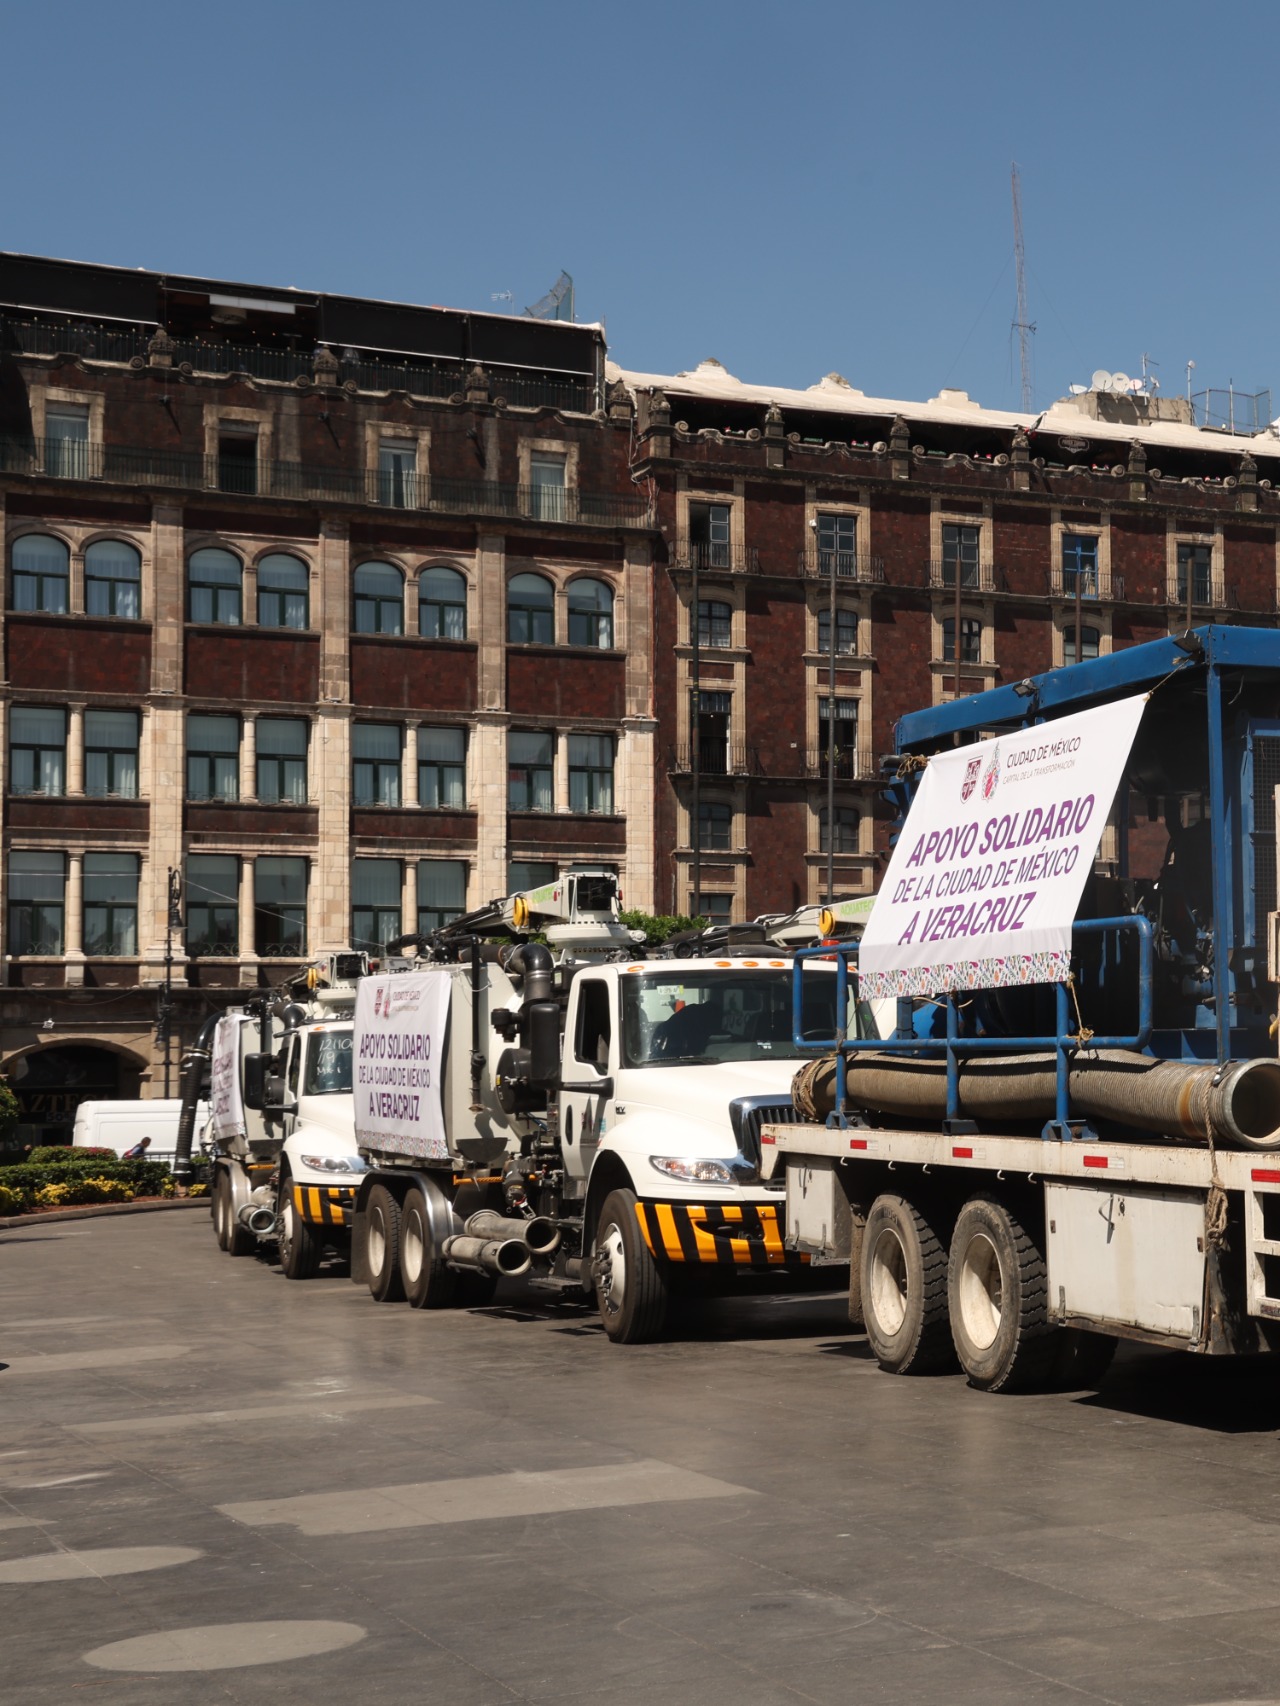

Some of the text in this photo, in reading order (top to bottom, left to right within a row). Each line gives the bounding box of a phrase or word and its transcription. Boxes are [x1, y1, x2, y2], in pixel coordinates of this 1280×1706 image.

[1006, 736, 1081, 768] CIUDAD DE MÉXICO
[905, 794, 1095, 868] APOYO SOLIDARIO
[891, 845, 1079, 904] DE LA CIUDAD DE MÉXICO
[898, 891, 1037, 946] A VERACRUZ
[359, 1033, 431, 1060] APOYO SOLIDARIO
[359, 1065, 366, 1084] DE
[366, 1066, 374, 1084] LA
[374, 1066, 397, 1086] CIUDAD
[397, 1067, 406, 1087] DE
[407, 1063, 431, 1088] MÉXICO
[369, 1092, 420, 1121] A VERACRUZ
